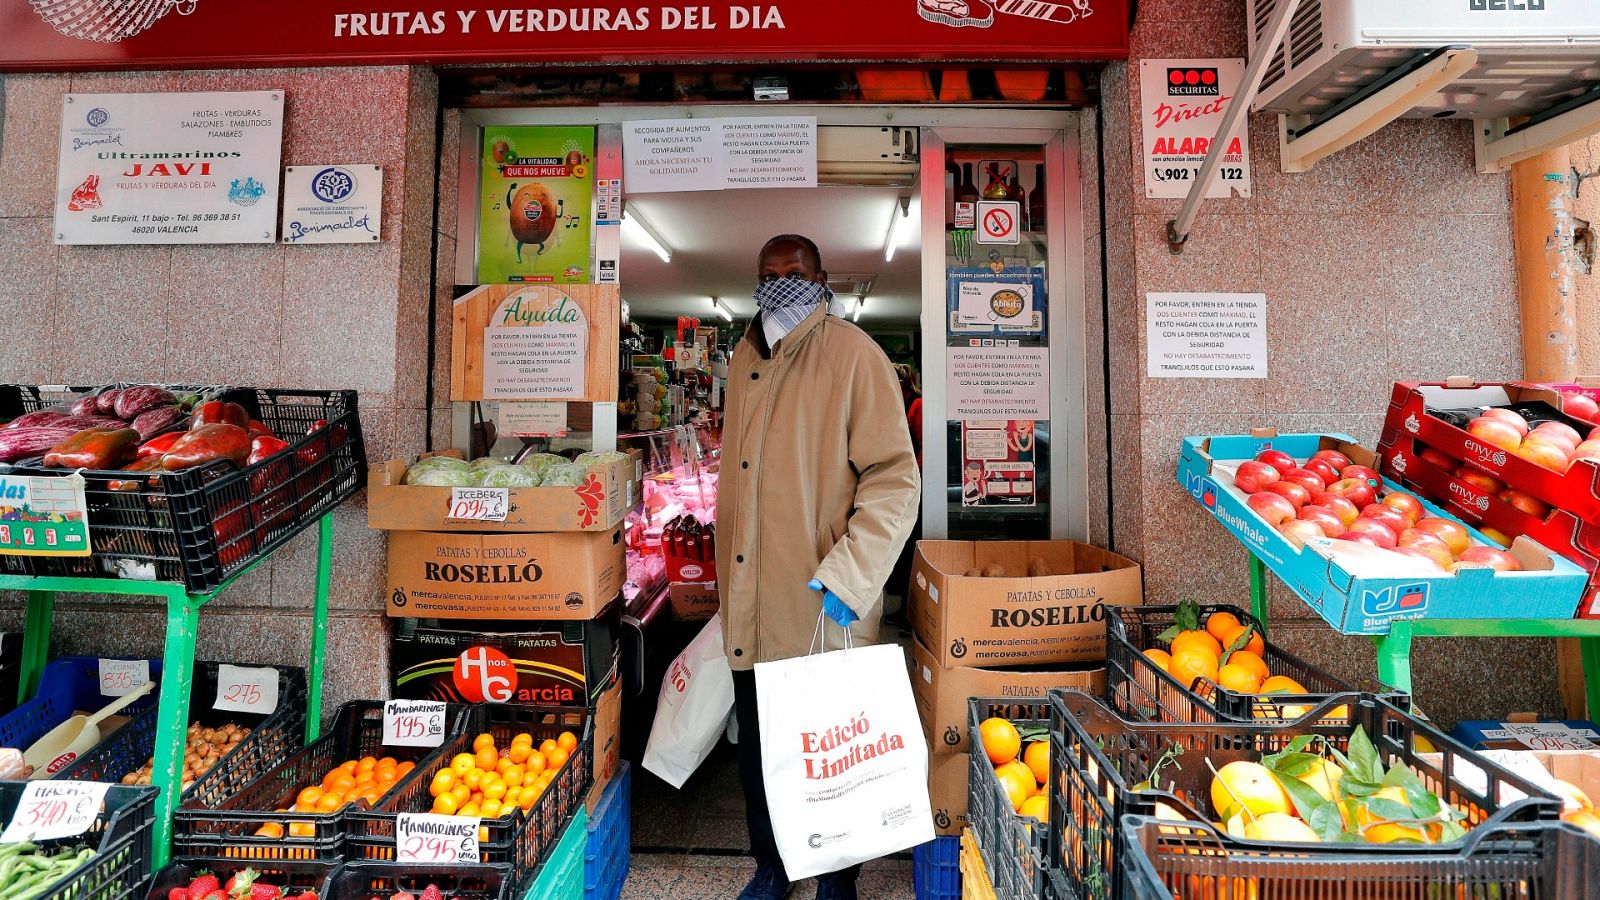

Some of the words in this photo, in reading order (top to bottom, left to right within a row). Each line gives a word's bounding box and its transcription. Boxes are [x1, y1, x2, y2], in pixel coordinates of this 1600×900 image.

[334, 10, 445, 37] FRUTAS
[455, 10, 476, 33] Y
[487, 6, 650, 33] VERDURAS
[661, 6, 717, 30] DEL
[729, 5, 786, 29] DIA
[1170, 86, 1218, 95] SECURITAS
[192, 110, 218, 118] FRUTAS
[224, 109, 261, 117] VERDURAS
[1152, 95, 1232, 129] Direct
[180, 120, 224, 129] SALAZONES
[230, 119, 272, 128] EMBUTIDOS
[208, 130, 243, 138] FIAMBRES
[660, 136, 685, 144] MOUSA
[652, 146, 695, 154] COMPAÑEROS
[1152, 138, 1243, 155] ALARA
[98, 150, 241, 160] Ultramarinos
[634, 158, 660, 166] AHORA
[122, 163, 212, 177] JAVI
[507, 168, 522, 176] QUE
[540, 167, 566, 175] MUEVE
[649, 167, 699, 175] SOLIDARIDAD
[1166, 168, 1189, 180] 902
[1220, 168, 1243, 180] 122
[116, 182, 143, 190] FRUTAS
[144, 182, 150, 190] Y
[151, 182, 188, 190] VERDURAS
[92, 214, 110, 223] Sant
[142, 214, 150, 222] 11
[152, 214, 170, 224] bajo
[176, 214, 191, 222] Tel.
[192, 214, 202, 222] 96
[203, 214, 219, 222] 369
[220, 214, 231, 222] 38
[132, 226, 155, 234] 46020
[156, 226, 199, 234] VALENCIA
[993, 300, 1022, 308] Abierto
[504, 296, 580, 327] Ayuda
[1464, 439, 1493, 462] envy
[458, 490, 504, 503] ICEBERG
[1450, 482, 1477, 505] envy
[436, 546, 471, 558] PATATAS
[474, 548, 480, 558] Y
[482, 546, 527, 559] CEBOLLAS
[424, 559, 543, 584] ROSELLÓ
[411, 590, 475, 602] mercavalencia,
[1007, 590, 1042, 603] PATATAS
[1046, 590, 1052, 601] Y
[1054, 587, 1096, 600] CEBOLLAS
[416, 602, 467, 613] mercovasa,
[990, 598, 1106, 628] ROSELLÓ
[420, 636, 456, 646] PATATAS
[518, 640, 557, 648] PATATAS
[973, 638, 1040, 646] mercavalencia,
[976, 651, 1029, 659] mercovasa,
[1002, 685, 1040, 697] PATATAS
[388, 703, 445, 717] MANDARINAS
[430, 715, 440, 728] €
[800, 711, 870, 754] Edició
[50, 753, 74, 771] FRIT
[804, 732, 905, 780] Limitada
[400, 816, 476, 837] MANDARINAS
[460, 837, 475, 852] €
